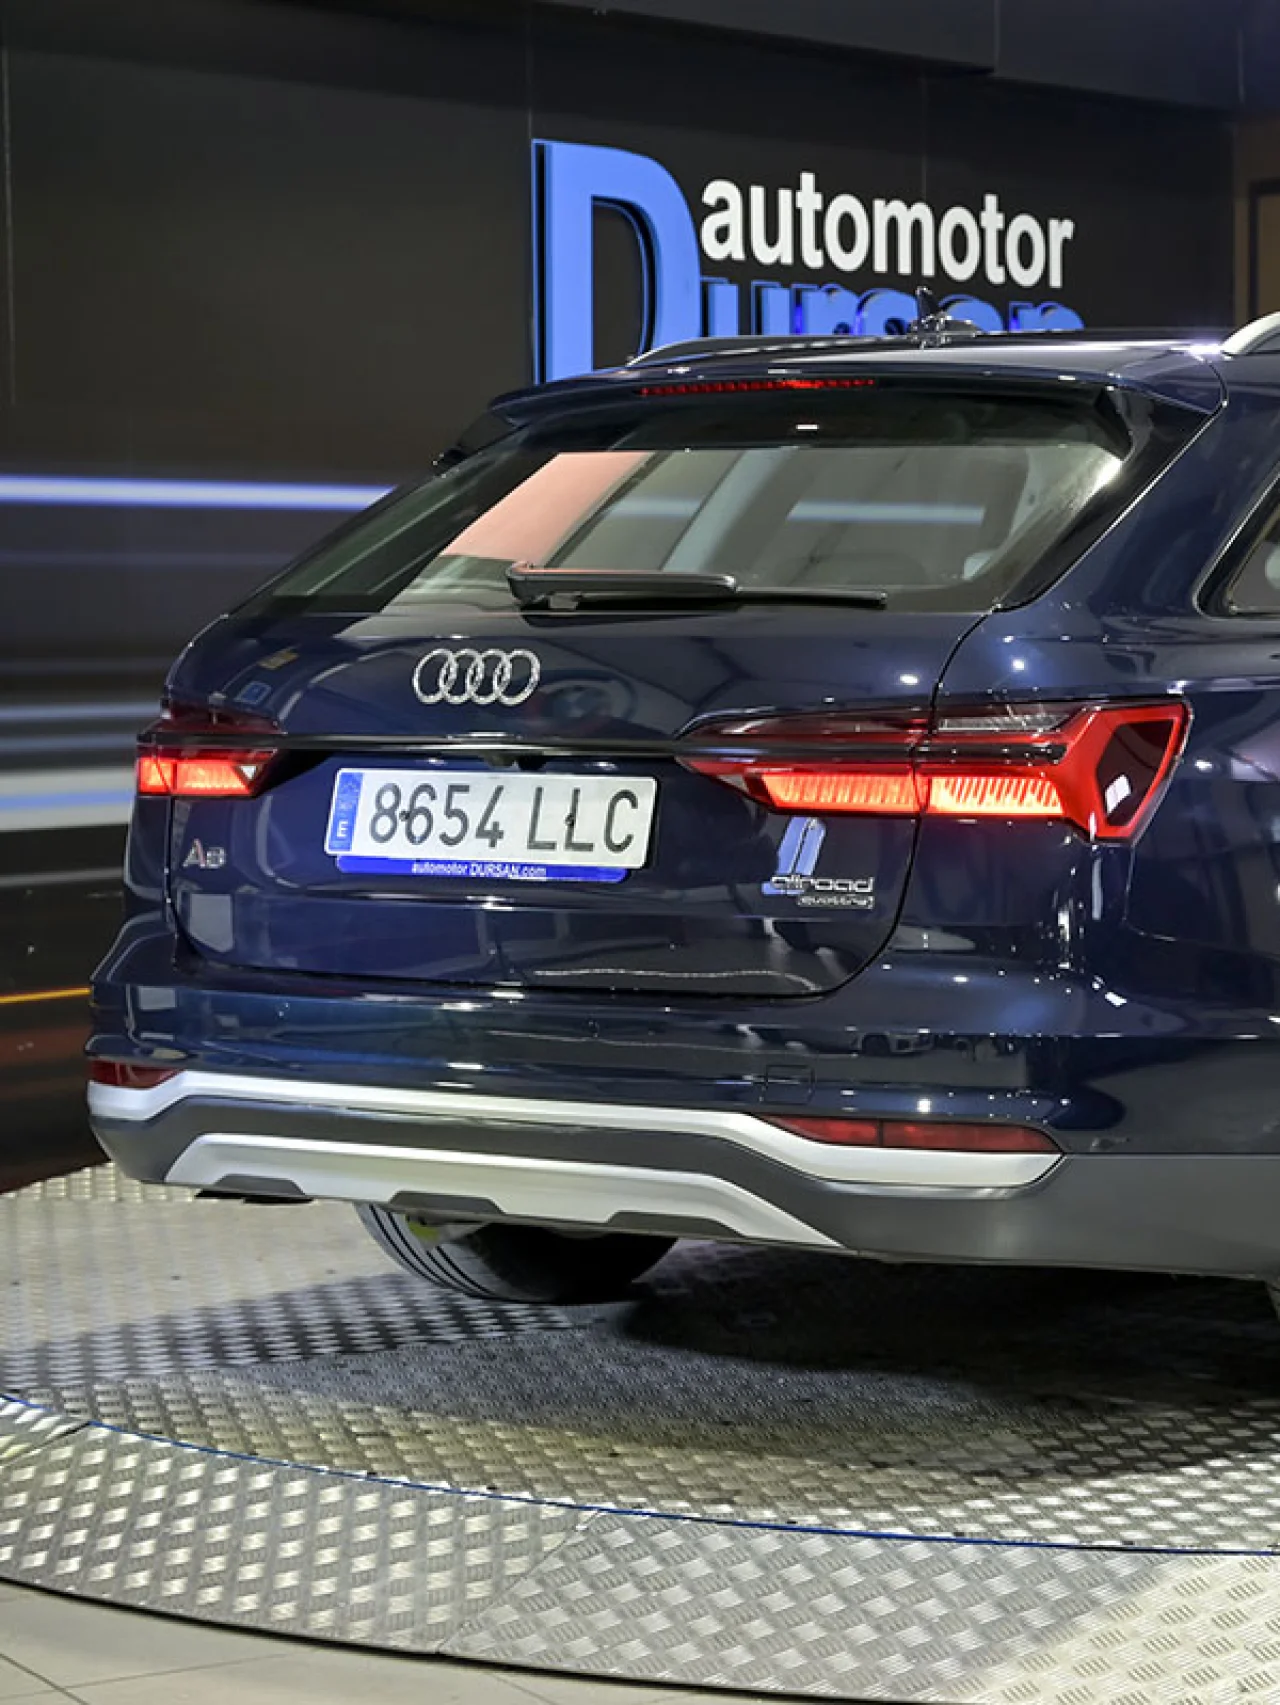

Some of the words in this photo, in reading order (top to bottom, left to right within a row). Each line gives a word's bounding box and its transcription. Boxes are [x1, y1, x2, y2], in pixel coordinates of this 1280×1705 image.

[701, 172, 1074, 288] automotor
[336, 820, 349, 838] E
[369, 783, 504, 847] 8654
[526, 786, 639, 852] LLC
[411, 861, 467, 875] automotor
